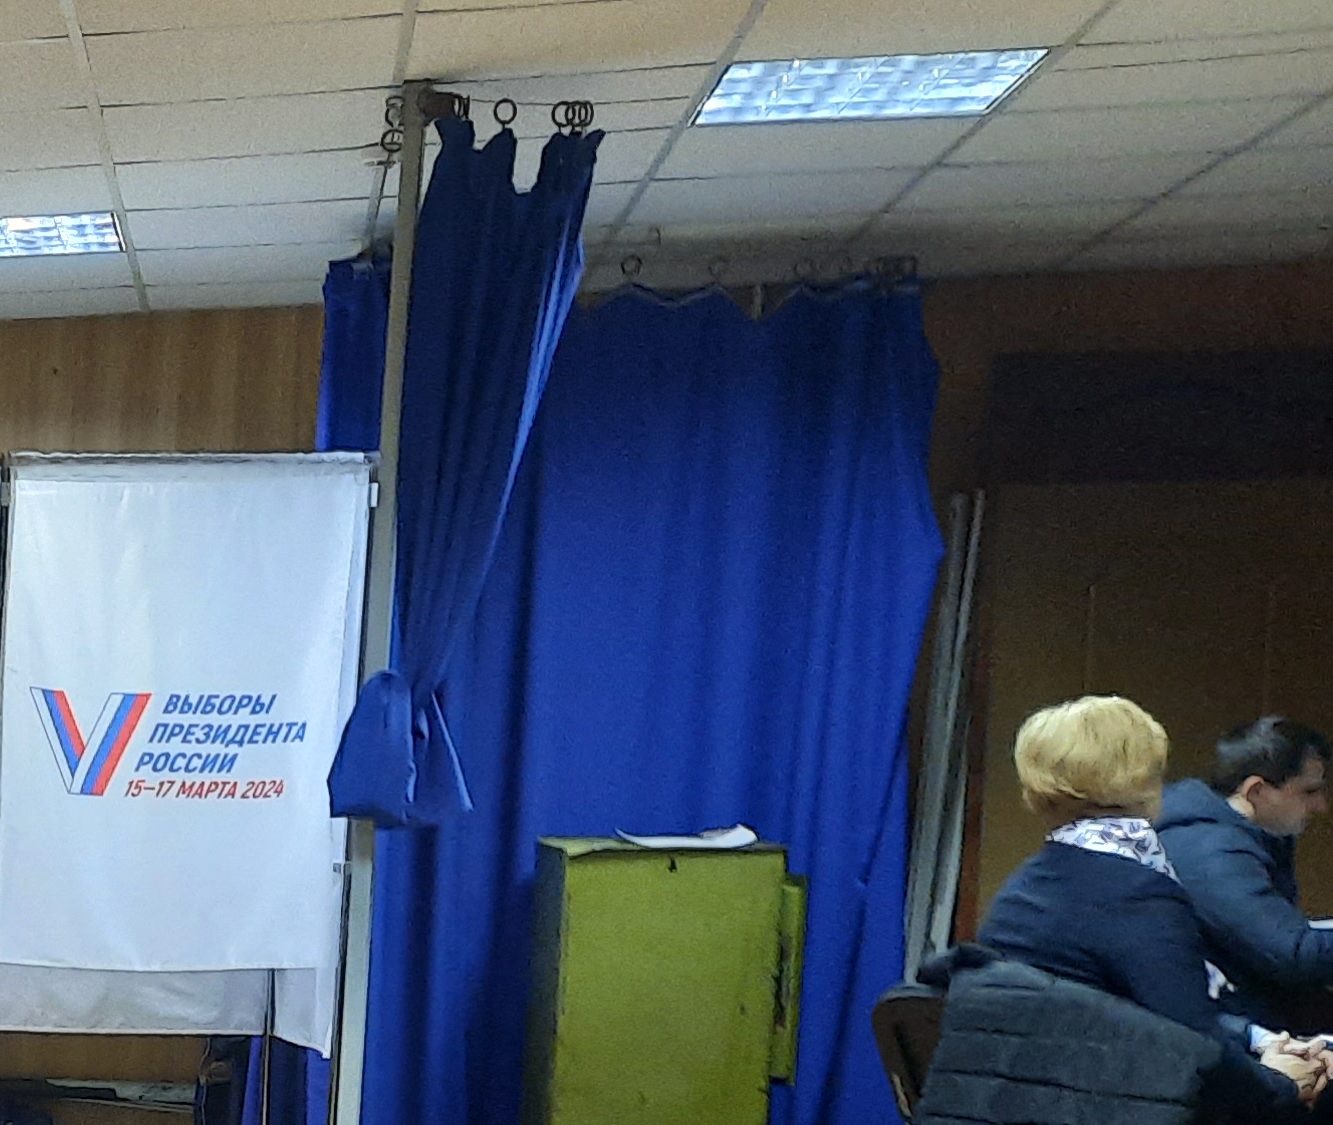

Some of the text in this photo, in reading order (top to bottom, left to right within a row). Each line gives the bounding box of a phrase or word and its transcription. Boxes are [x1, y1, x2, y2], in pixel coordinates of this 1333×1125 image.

[162, 693, 277, 715] ВЫБОРЫ
[148, 721, 307, 748] ПРЕЗИДЕНТА
[133, 752, 238, 774] РОССИИ
[175, 781, 237, 799] МАРТА
[240, 780, 286, 799] 2024
